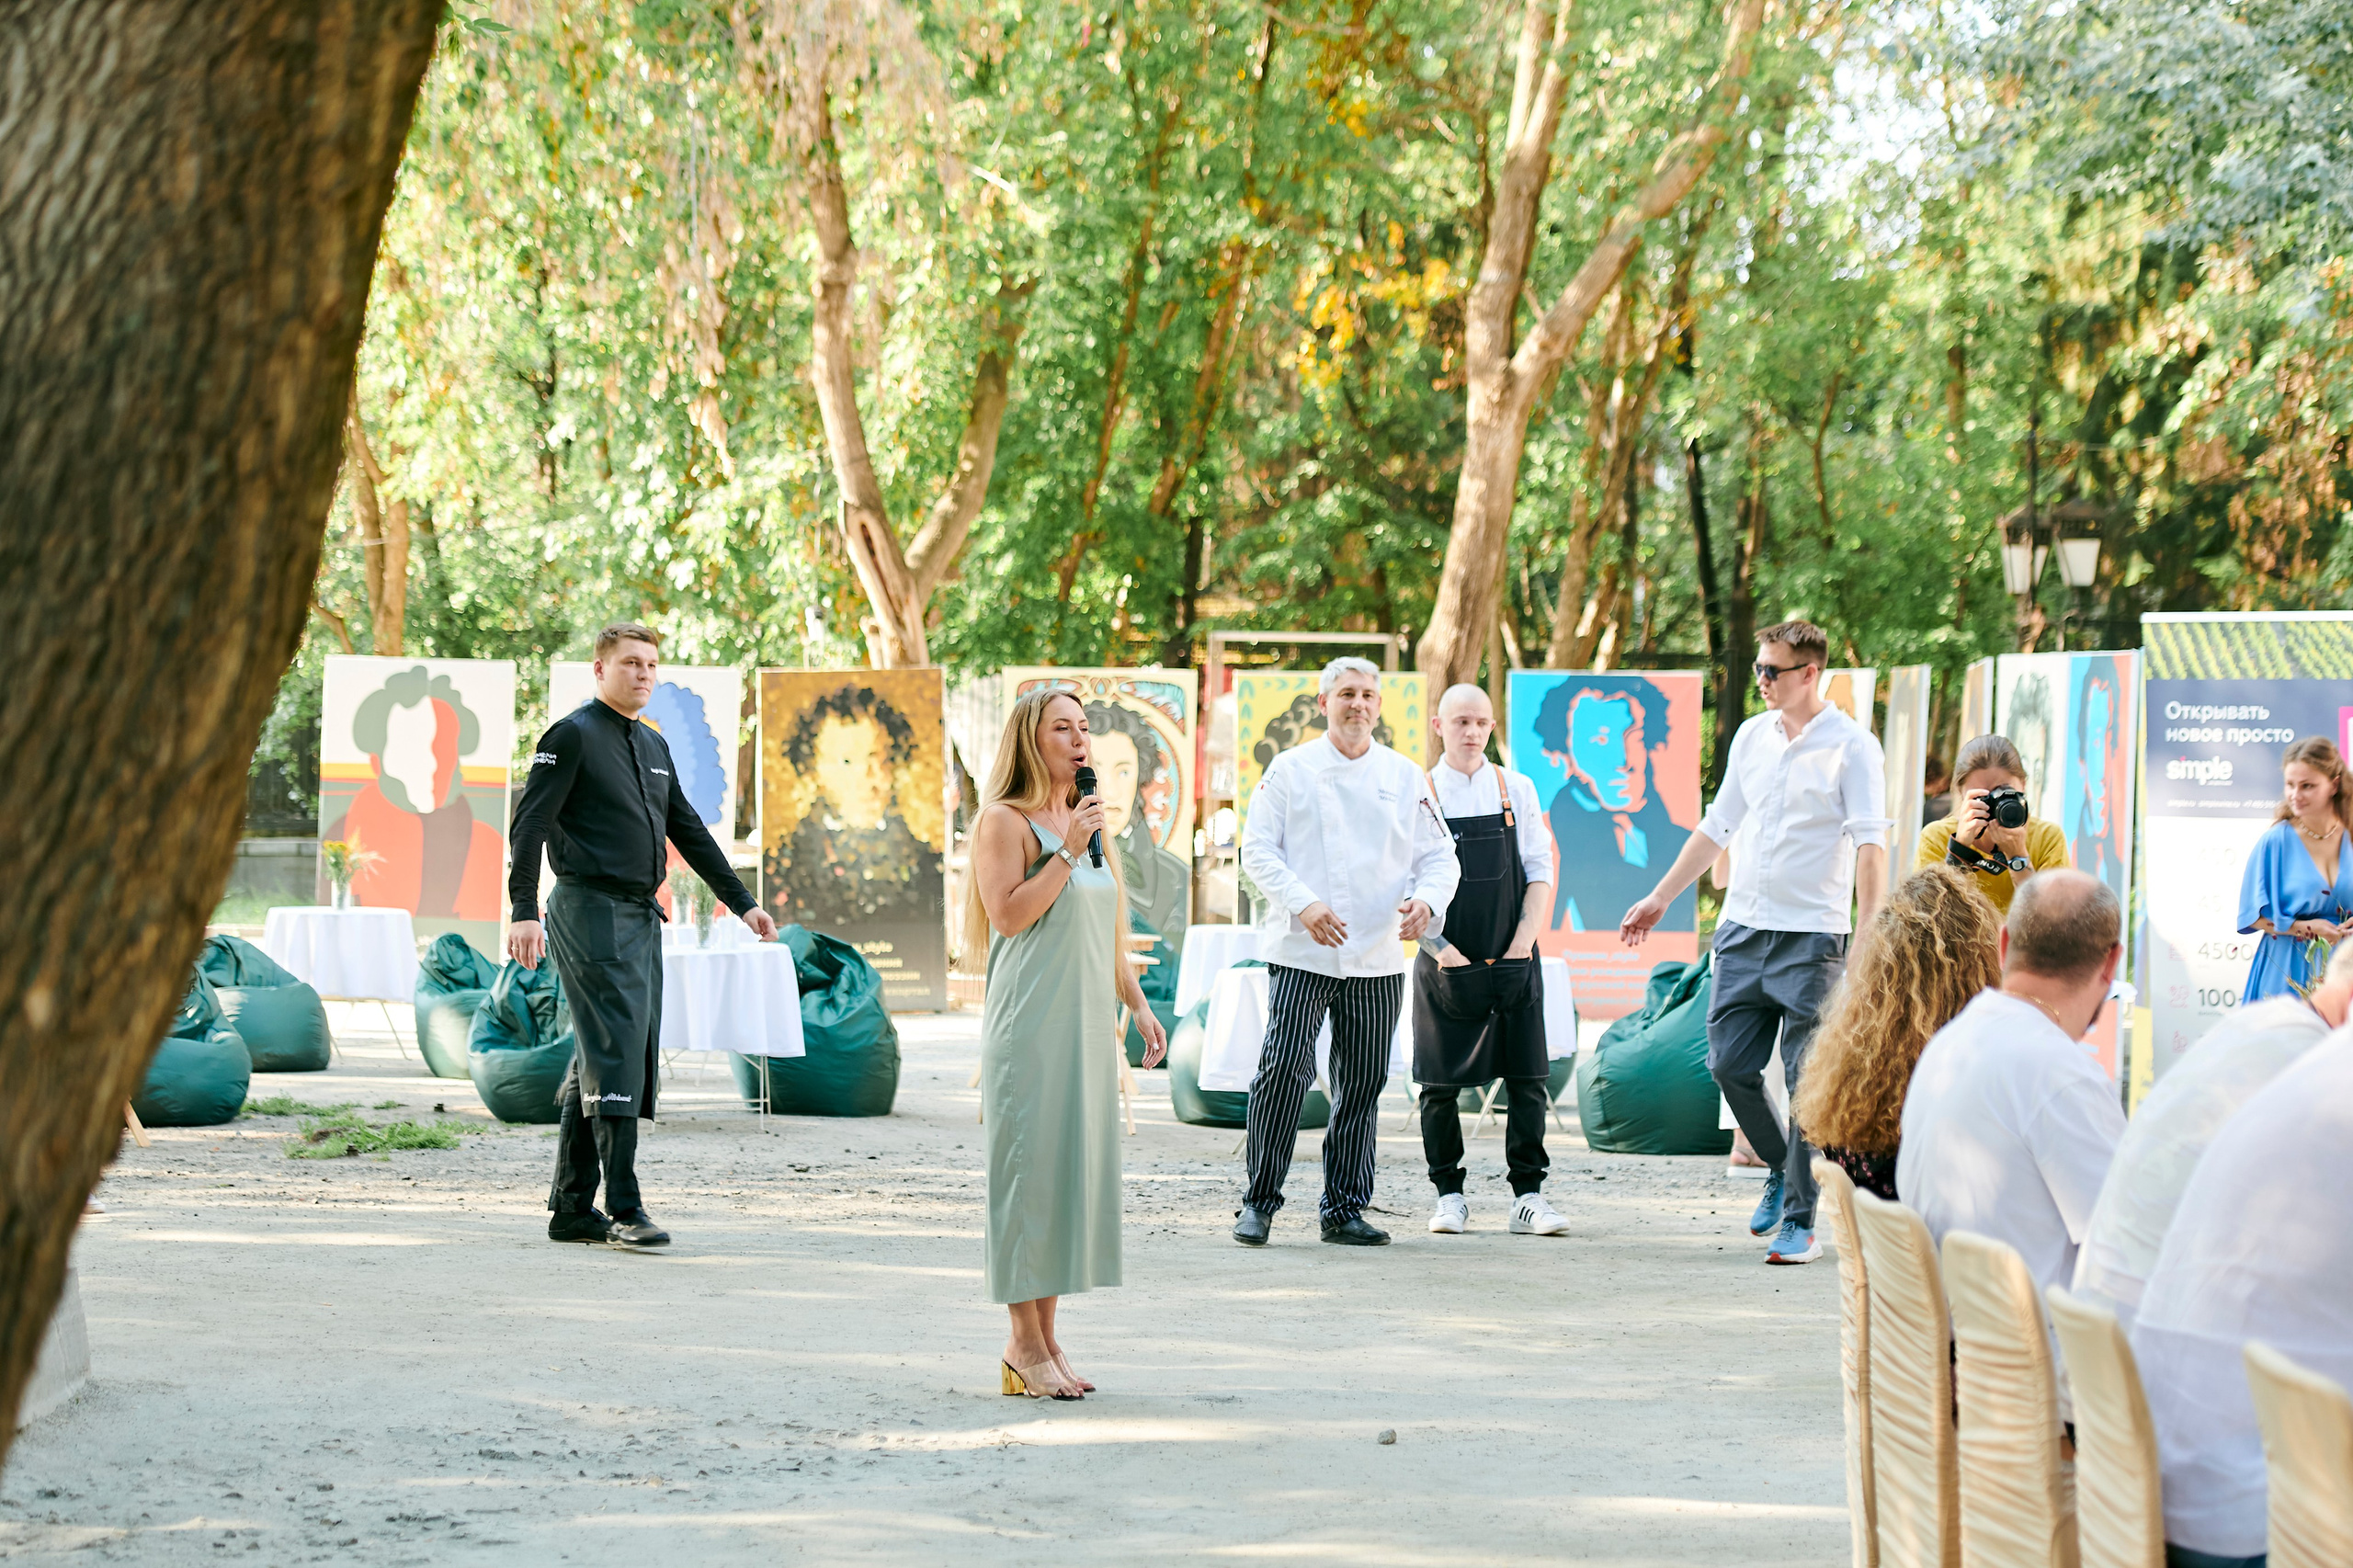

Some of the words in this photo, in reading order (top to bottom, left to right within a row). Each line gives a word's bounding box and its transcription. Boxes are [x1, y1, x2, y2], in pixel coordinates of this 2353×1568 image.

[2165, 700, 2270, 723] Открывать
[2165, 727, 2223, 743] новое
[2225, 728, 2295, 746] просто
[2166, 756, 2234, 786] simple
